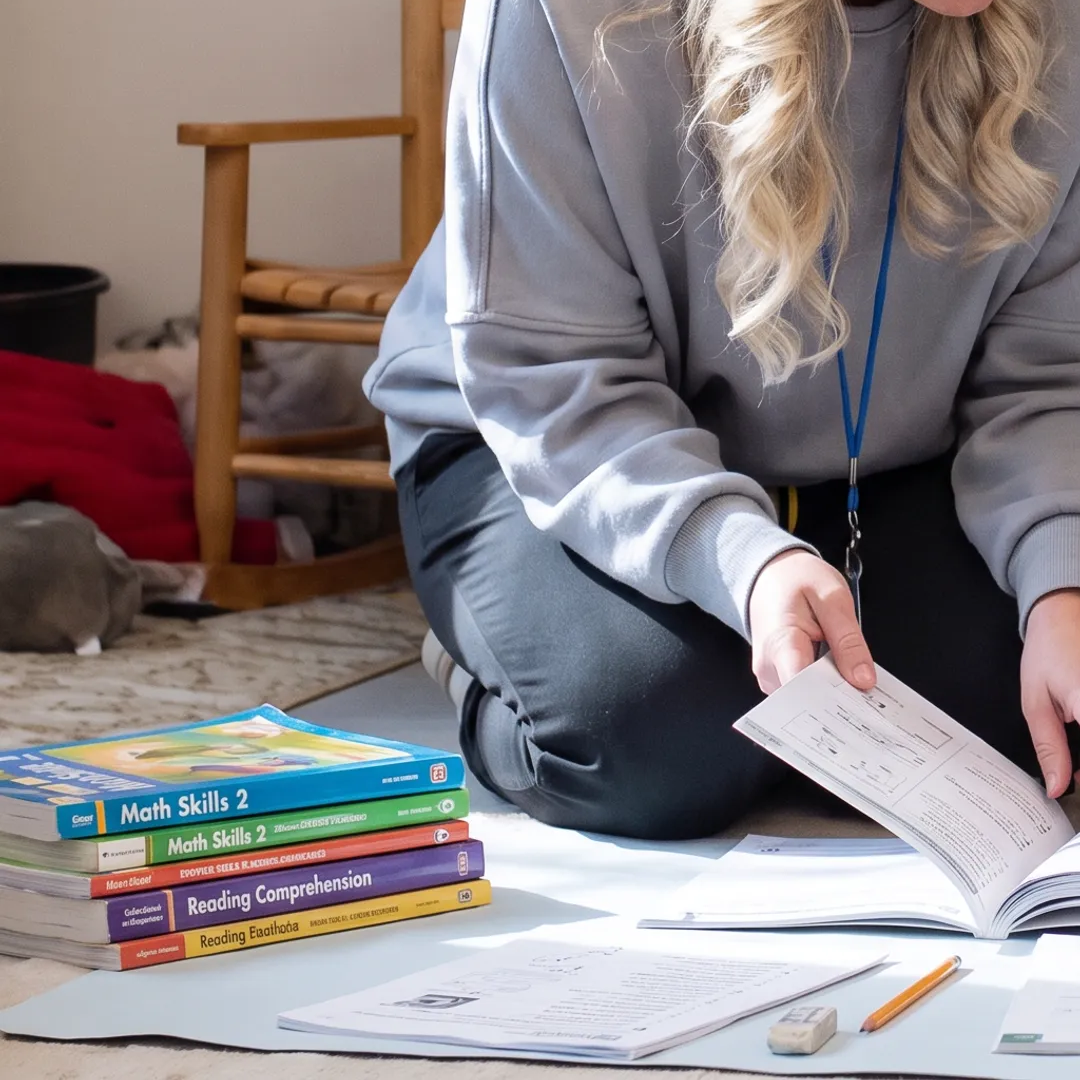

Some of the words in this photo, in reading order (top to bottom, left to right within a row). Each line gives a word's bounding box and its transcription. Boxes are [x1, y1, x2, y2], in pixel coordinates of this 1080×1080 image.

[120, 797, 171, 825] Math
[178, 790, 229, 818] Skills
[236, 788, 249, 810] 2
[167, 832, 208, 856] Math
[212, 826, 252, 850] Skills
[256, 825, 267, 843] 2
[187, 890, 251, 916] Reading
[255, 869, 372, 905] Comprehension
[200, 929, 246, 949] Reading
